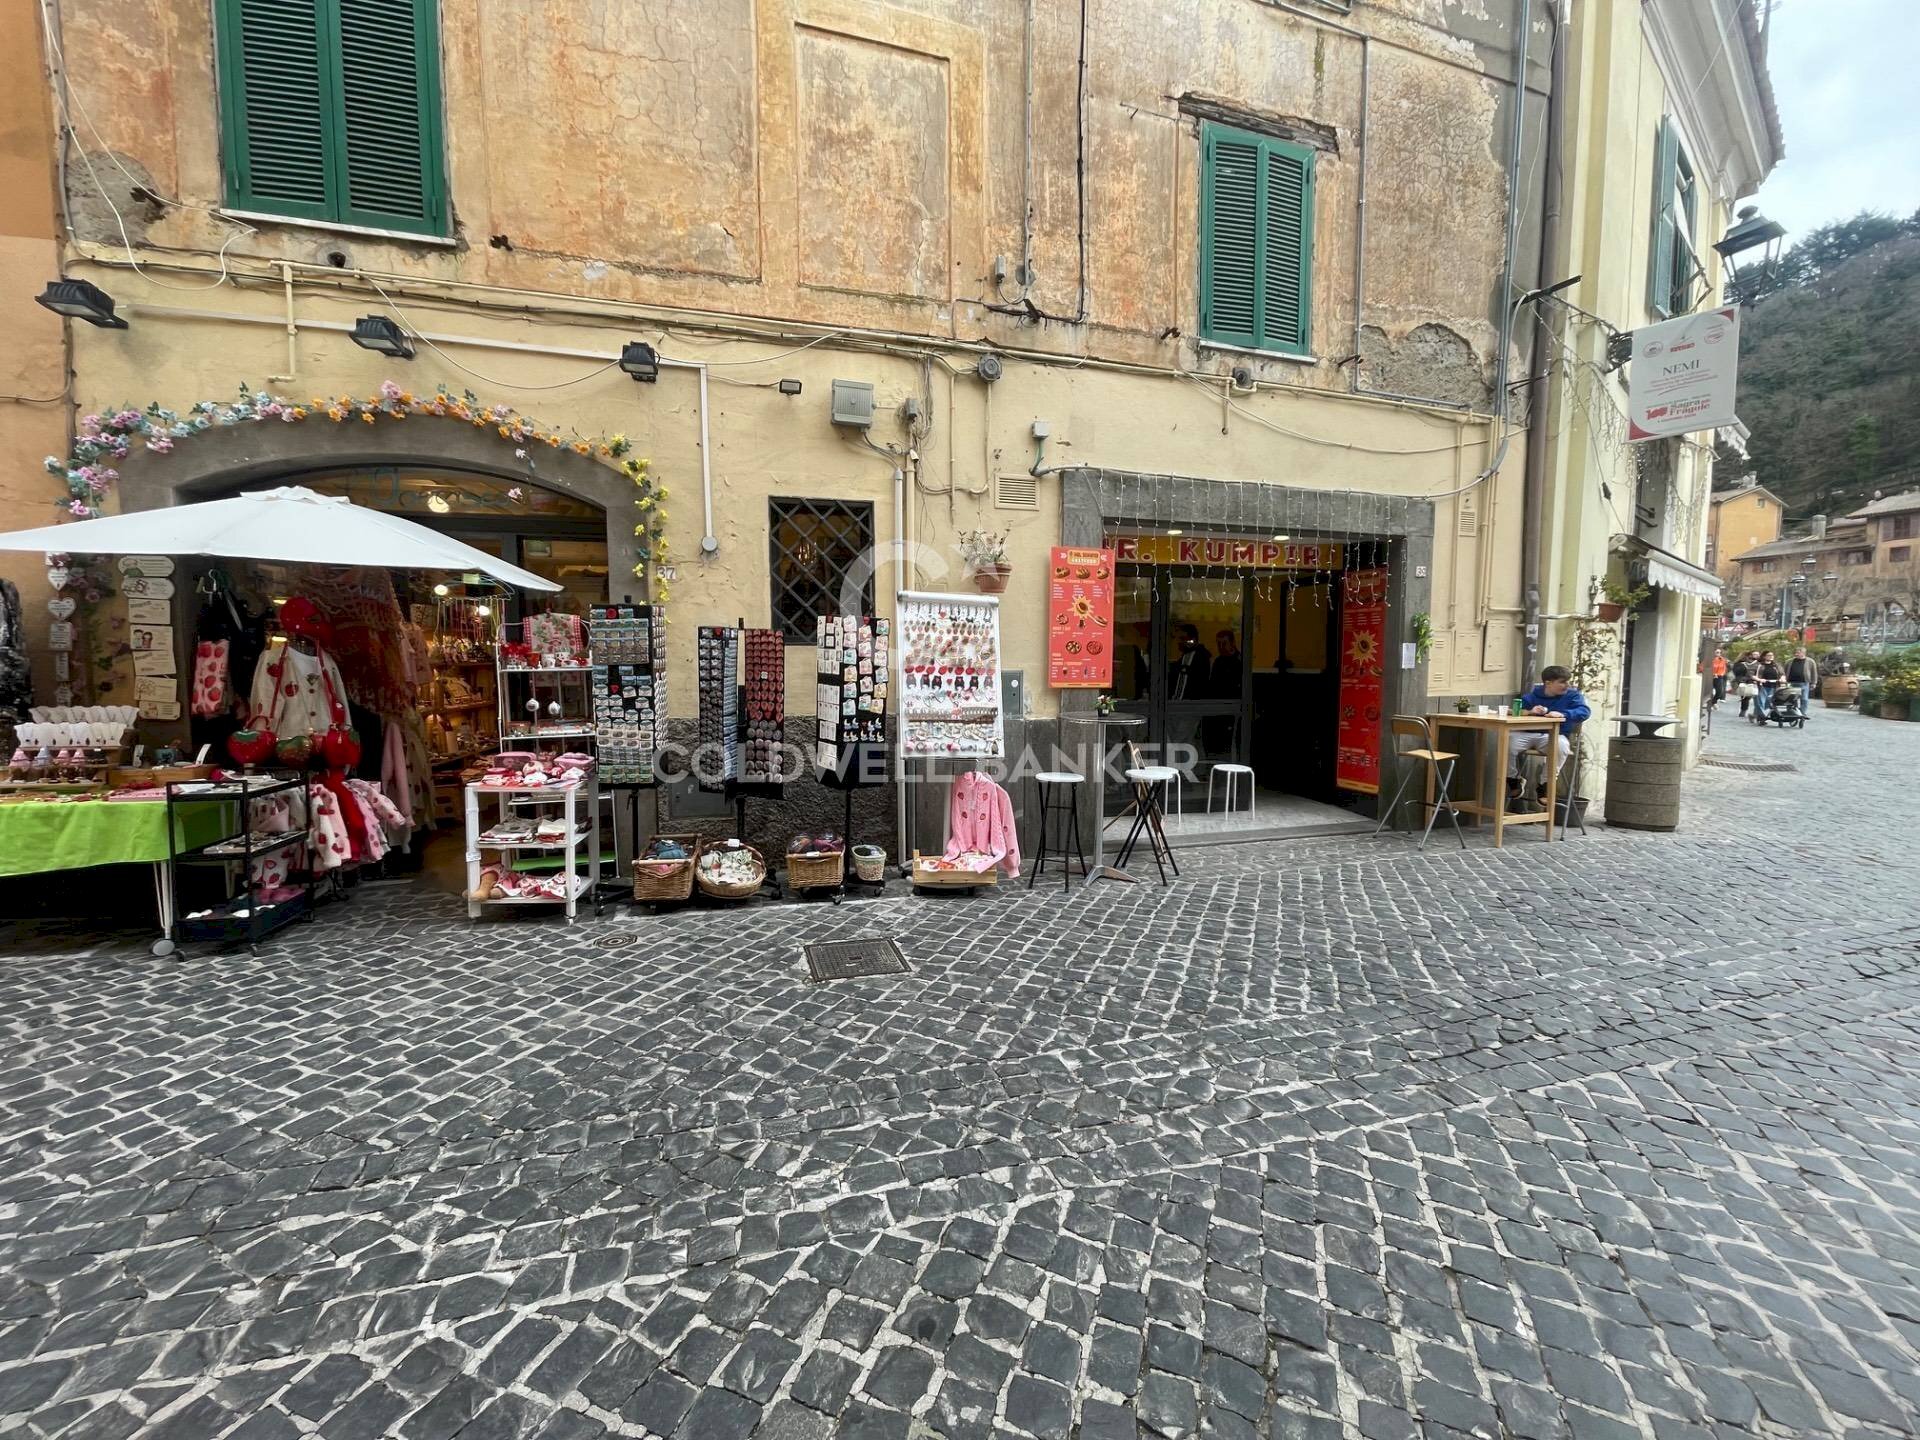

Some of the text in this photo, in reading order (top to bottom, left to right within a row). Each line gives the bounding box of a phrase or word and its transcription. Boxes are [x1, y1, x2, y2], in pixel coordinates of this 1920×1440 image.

[1663, 359, 1701, 376] NEMI
[1103, 537, 1321, 567] R. KUMPIR
[657, 566, 675, 579] 37
